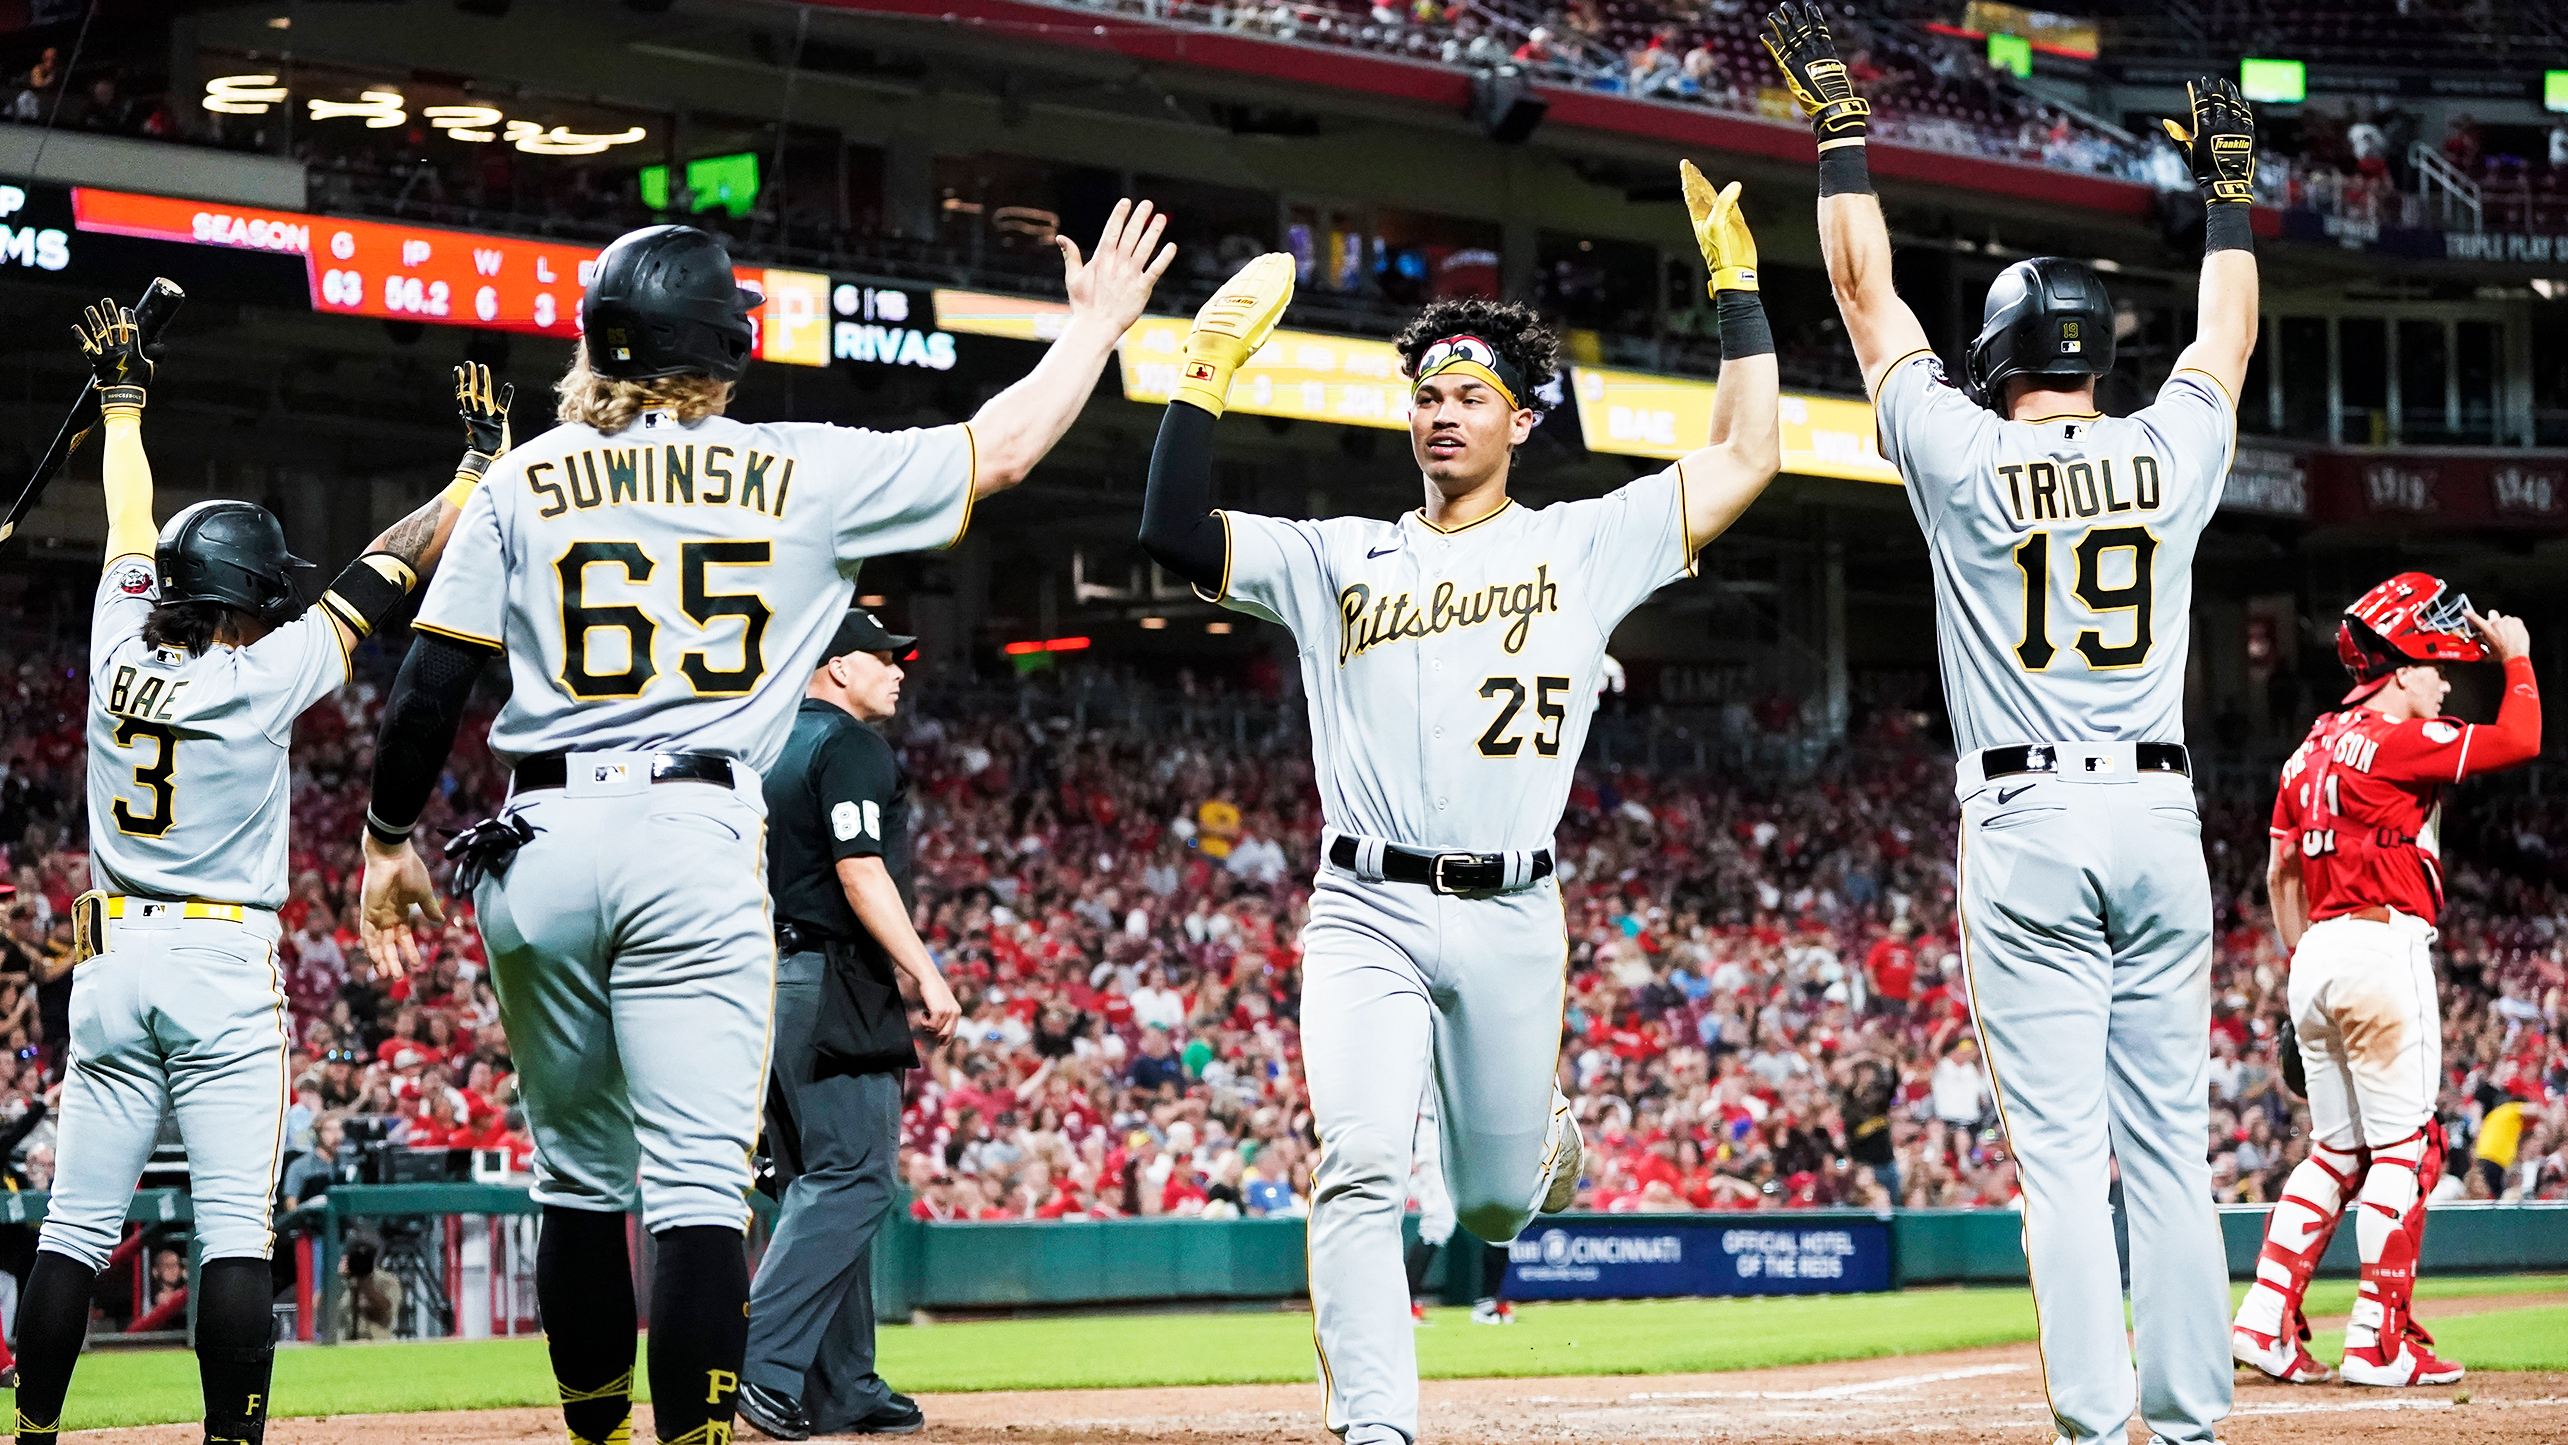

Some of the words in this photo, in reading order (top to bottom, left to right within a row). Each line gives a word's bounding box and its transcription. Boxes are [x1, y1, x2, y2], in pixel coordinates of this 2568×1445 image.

[1810, 62, 1843, 77] Franklin
[2214, 137, 2250, 151] Franklin
[192, 212, 309, 250] SEASON
[473, 247, 503, 277] W
[537, 255, 557, 284] L
[475, 285, 498, 321] 6
[534, 292, 557, 327] 3
[2063, 322, 2079, 339] 19
[834, 321, 957, 371] RIVAS
[525, 443, 796, 521] SUWINSKI
[1997, 454, 2162, 523] TRIOLO
[551, 540, 776, 702] 65
[1339, 563, 1559, 671] Pittsburgh
[2011, 523, 2162, 674] 19
[109, 665, 190, 722] BAE
[1473, 674, 1571, 760] 25
[110, 714, 179, 840] 3
[1721, 1229, 1798, 1255] OFFICIAL
[1799, 1230, 1856, 1256] HOTEL
[1736, 1254, 1762, 1279] OF
[1764, 1254, 1797, 1279] THE
[1798, 1254, 1844, 1279] REDS
[705, 1368, 739, 1405] P
